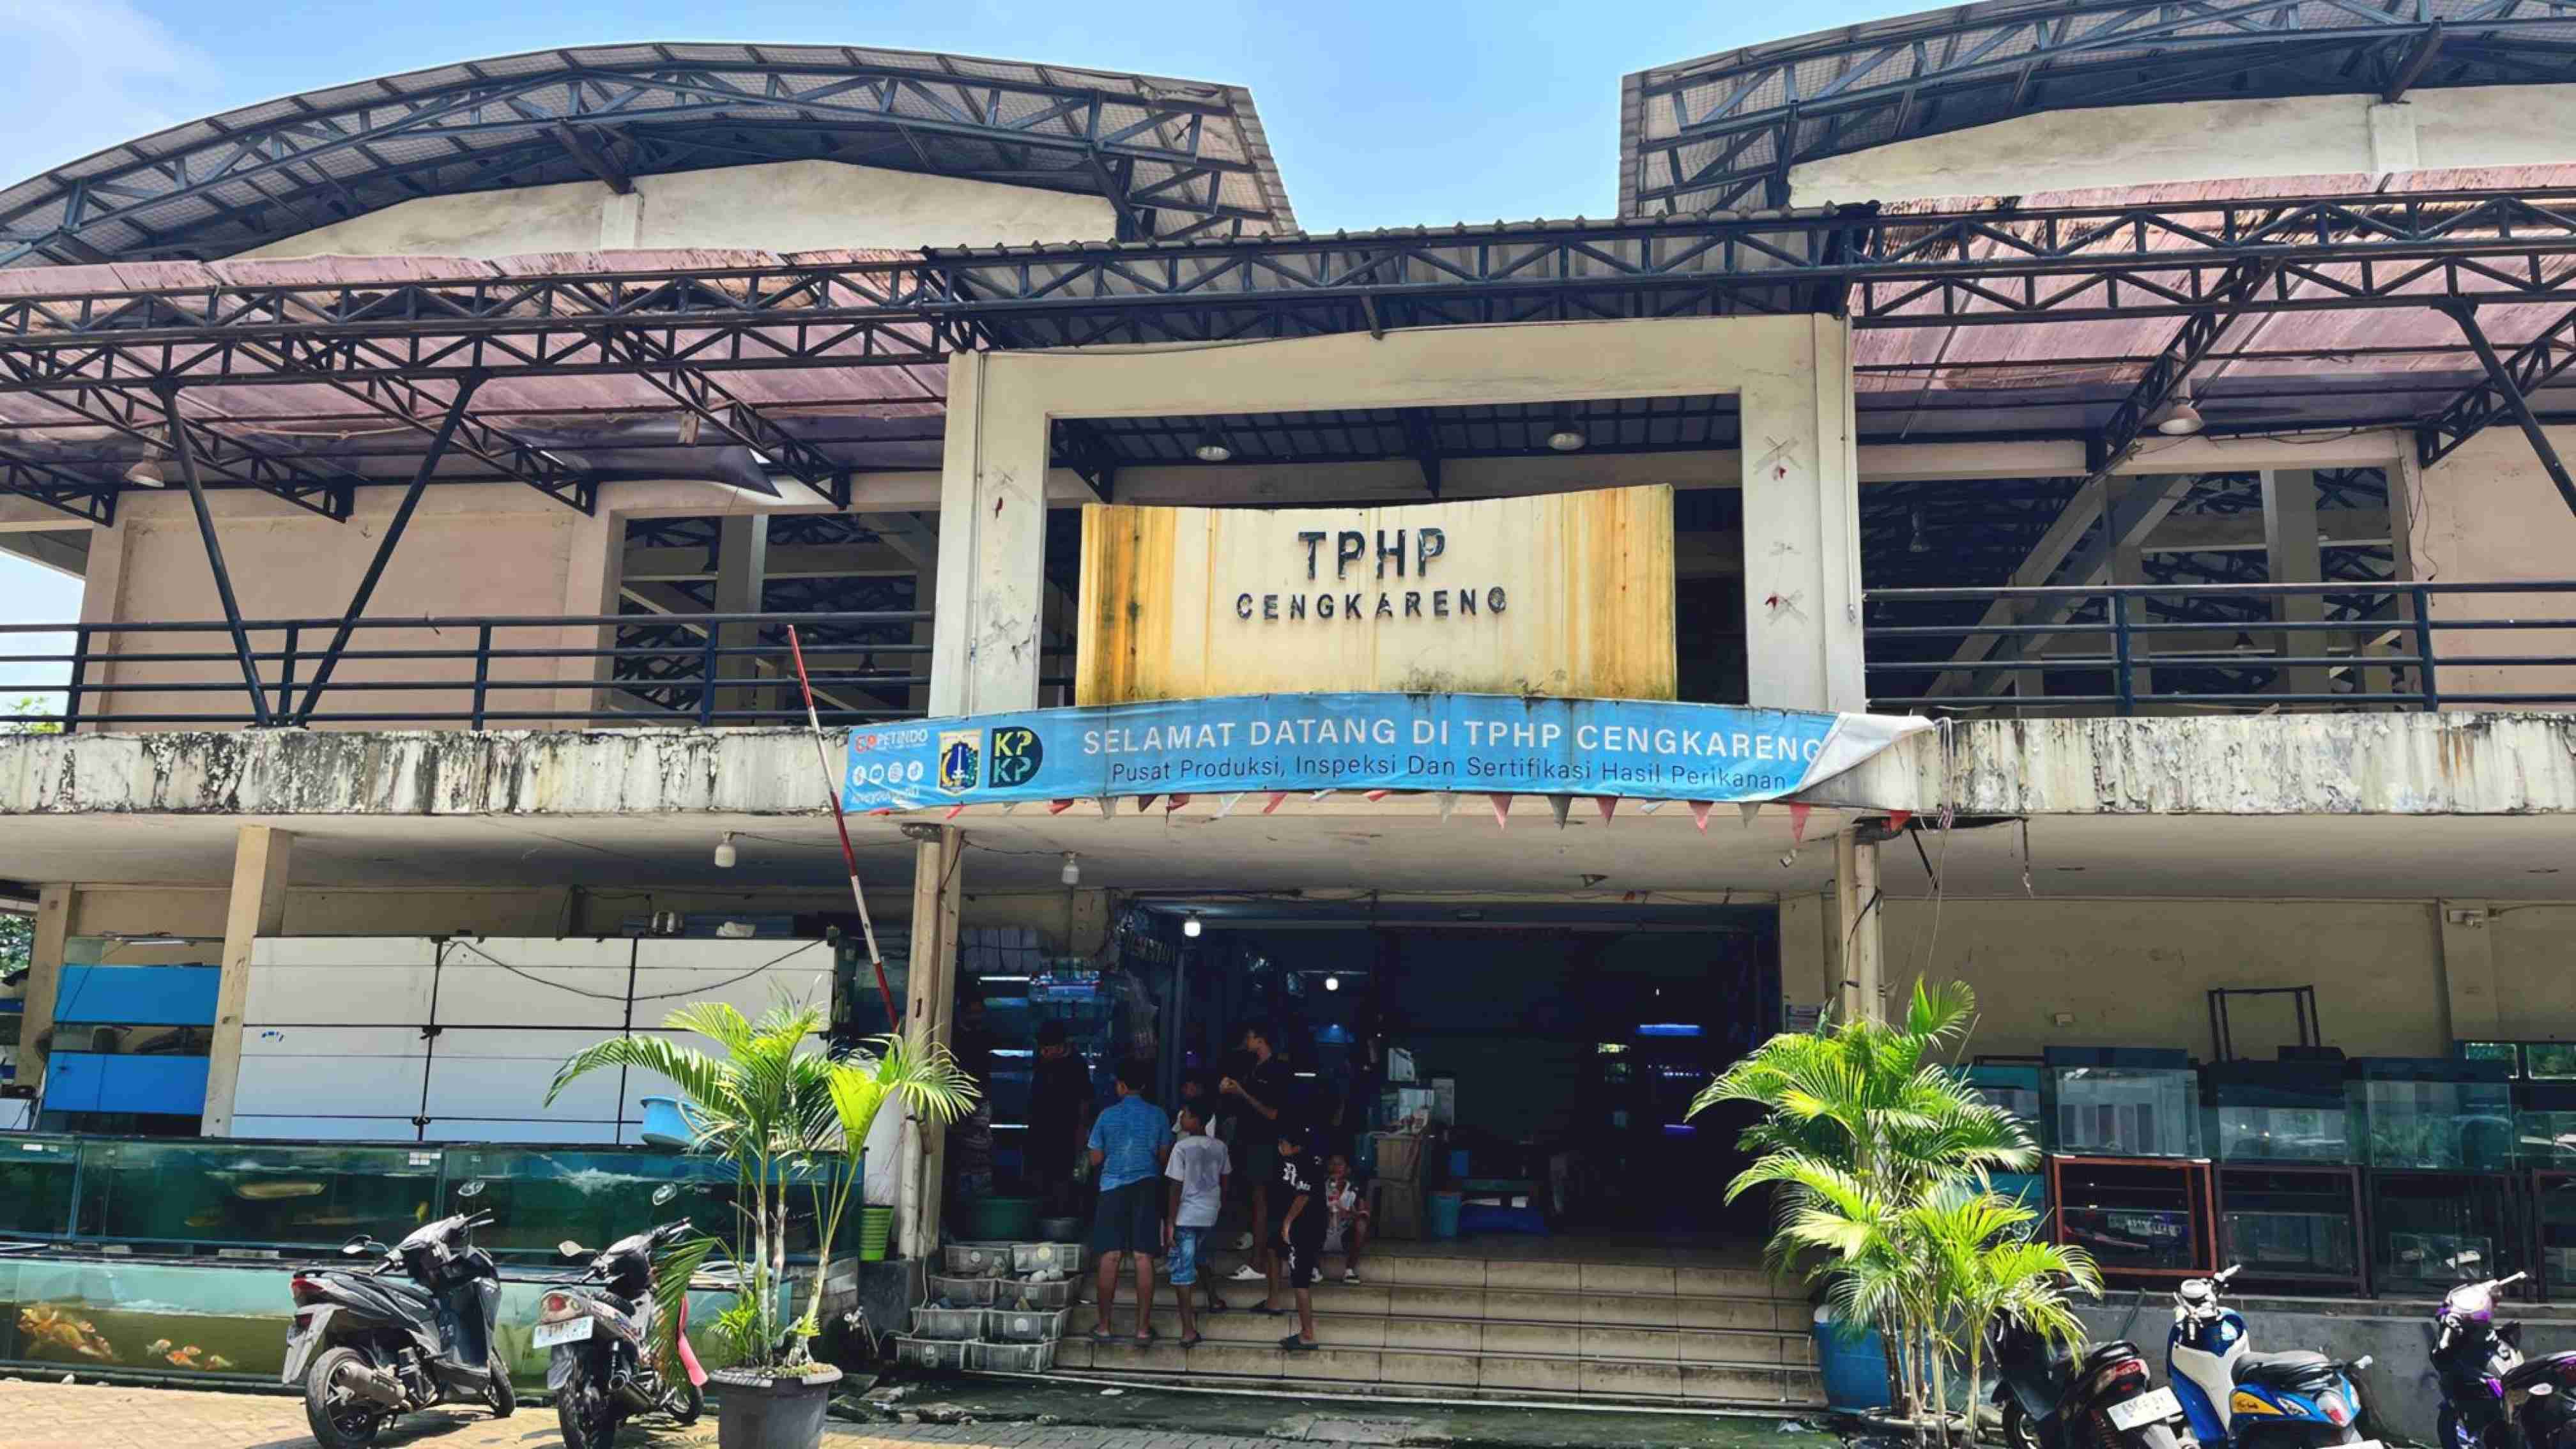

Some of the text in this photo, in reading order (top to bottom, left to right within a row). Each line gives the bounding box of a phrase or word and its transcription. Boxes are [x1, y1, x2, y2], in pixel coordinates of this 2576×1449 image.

[1298, 528, 1446, 579] TPHP
[1084, 723, 1236, 755] SELAMAT
[1250, 719, 1397, 746] DATANG
[1413, 719, 1448, 745] DI
[1464, 721, 1561, 748] TPHP
[1112, 755, 1786, 790] Pusat Produksi, Inspeksi Dan Sertifikasi Hasil Perikanan
